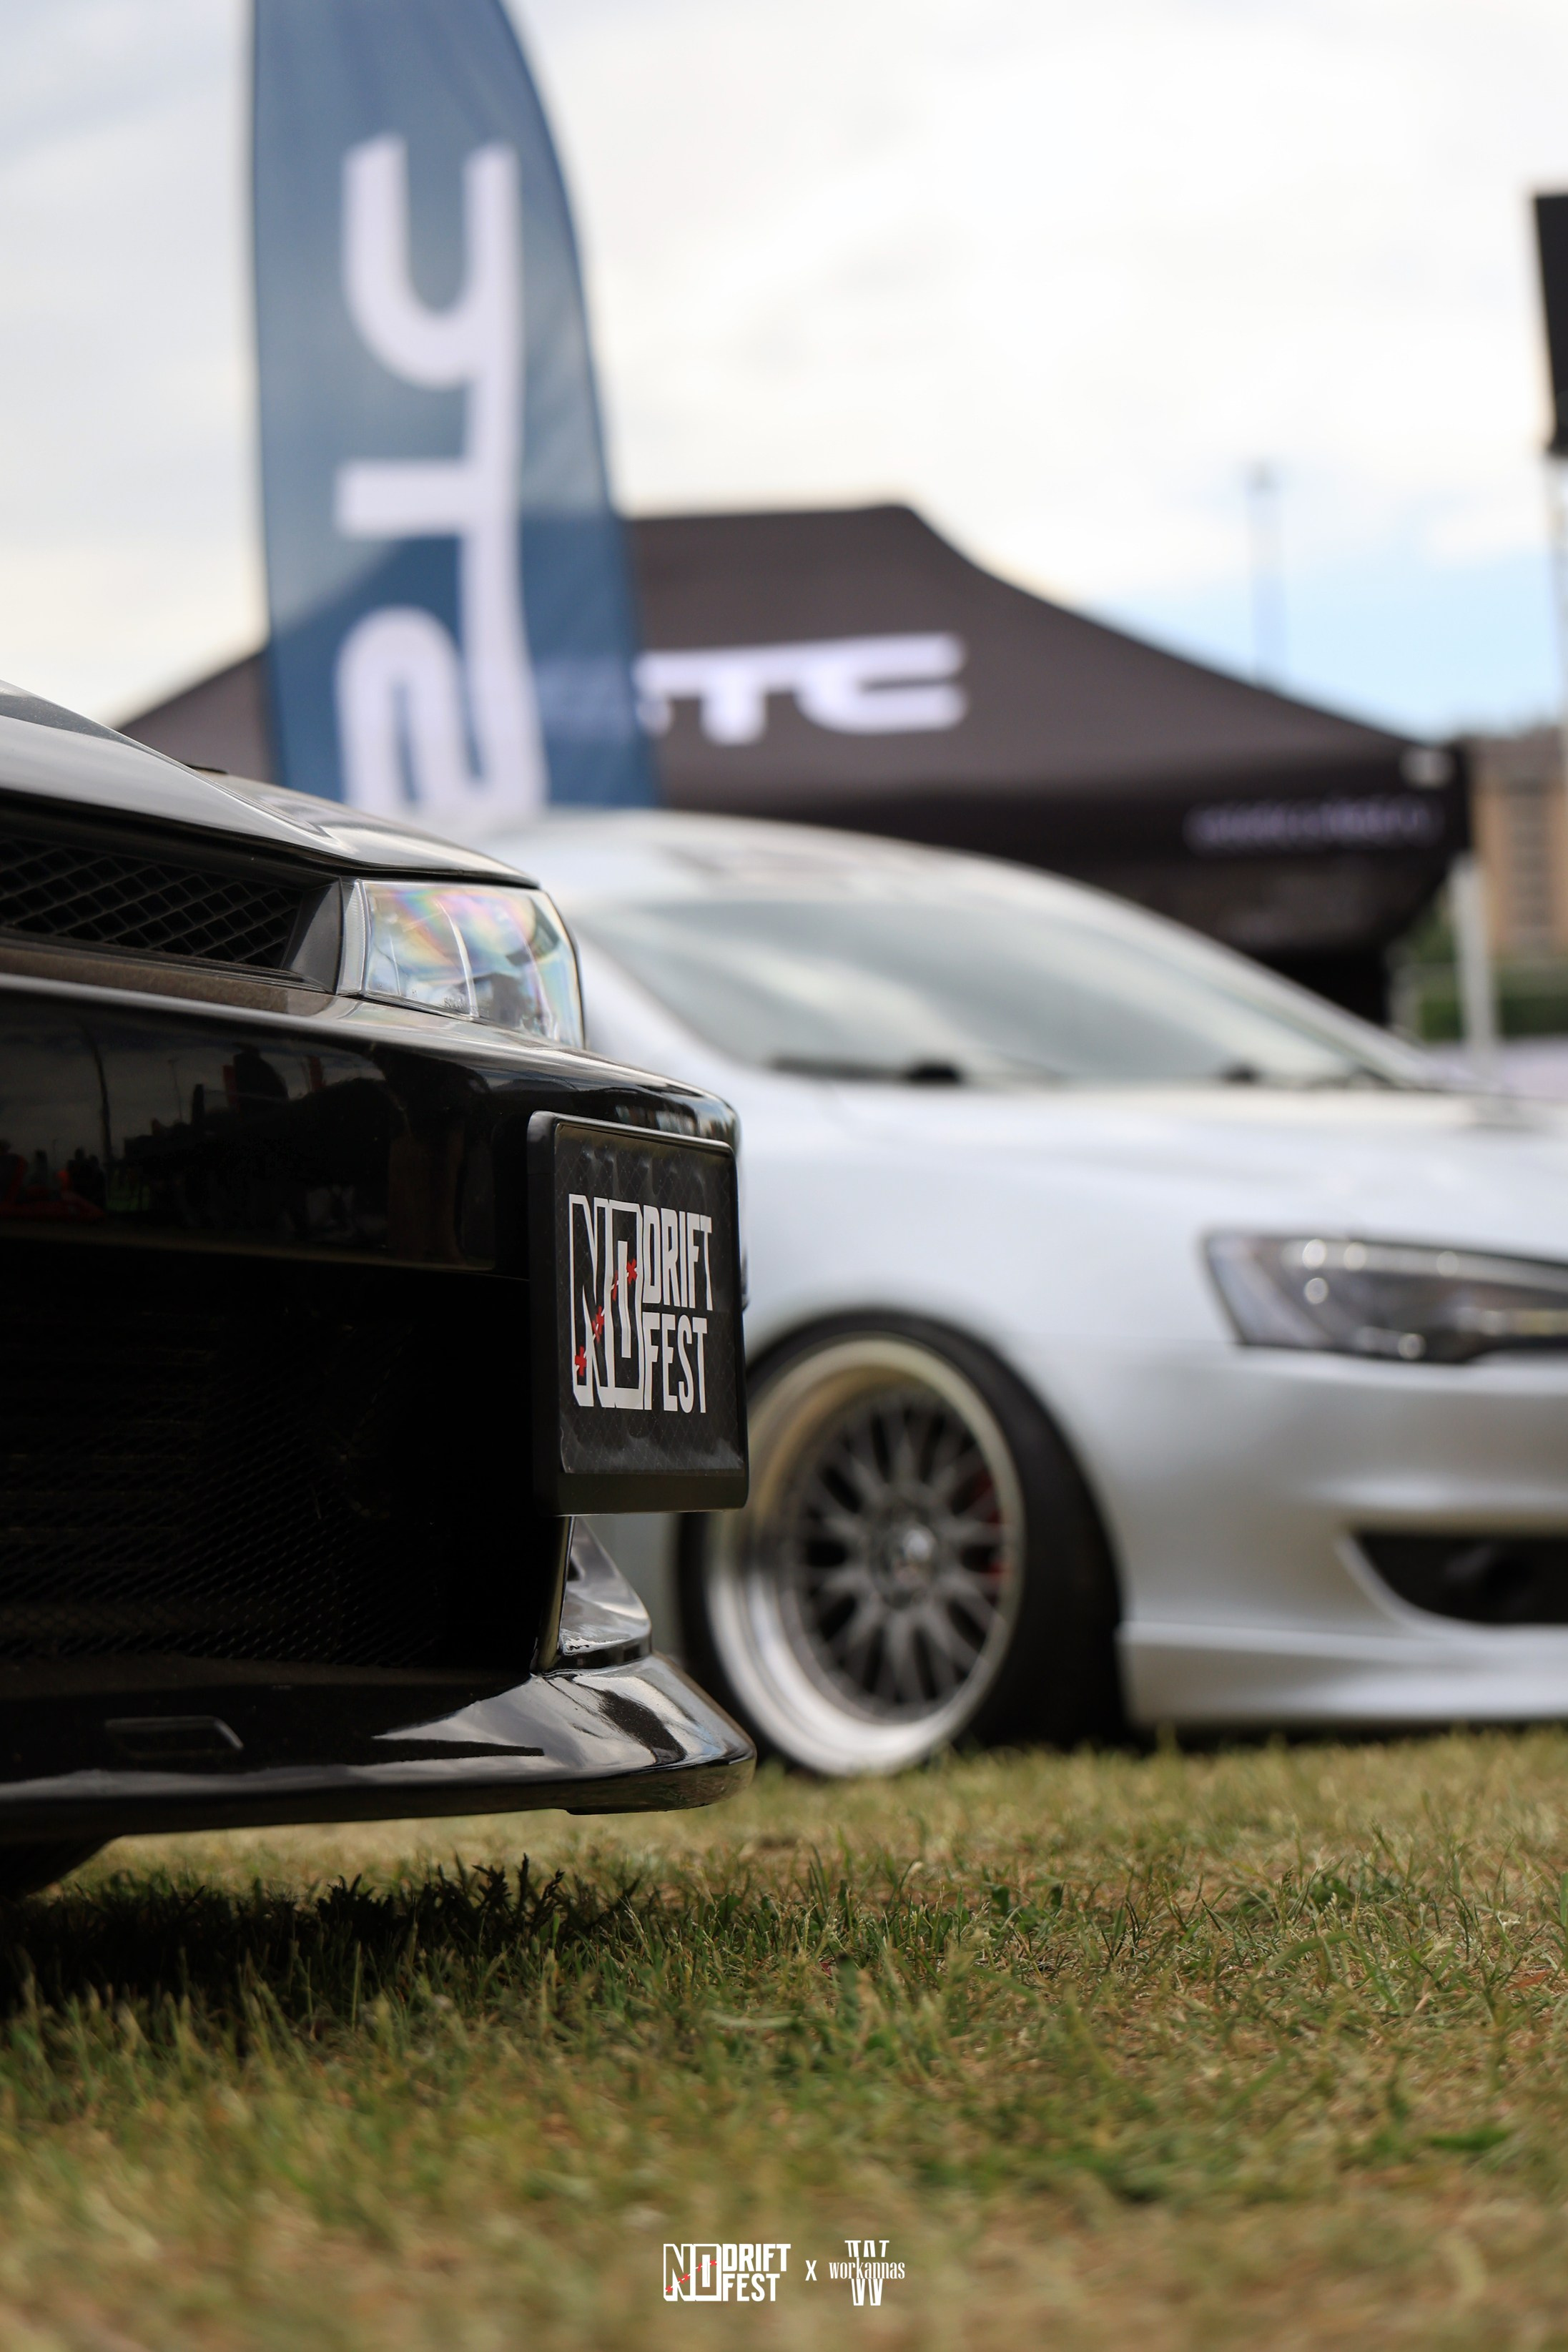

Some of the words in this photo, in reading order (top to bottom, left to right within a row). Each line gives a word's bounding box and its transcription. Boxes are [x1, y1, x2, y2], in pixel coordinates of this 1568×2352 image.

[633, 632, 967, 745] TC
[643, 1204, 714, 1312] DRIFT
[643, 1312, 708, 1414] FEST
